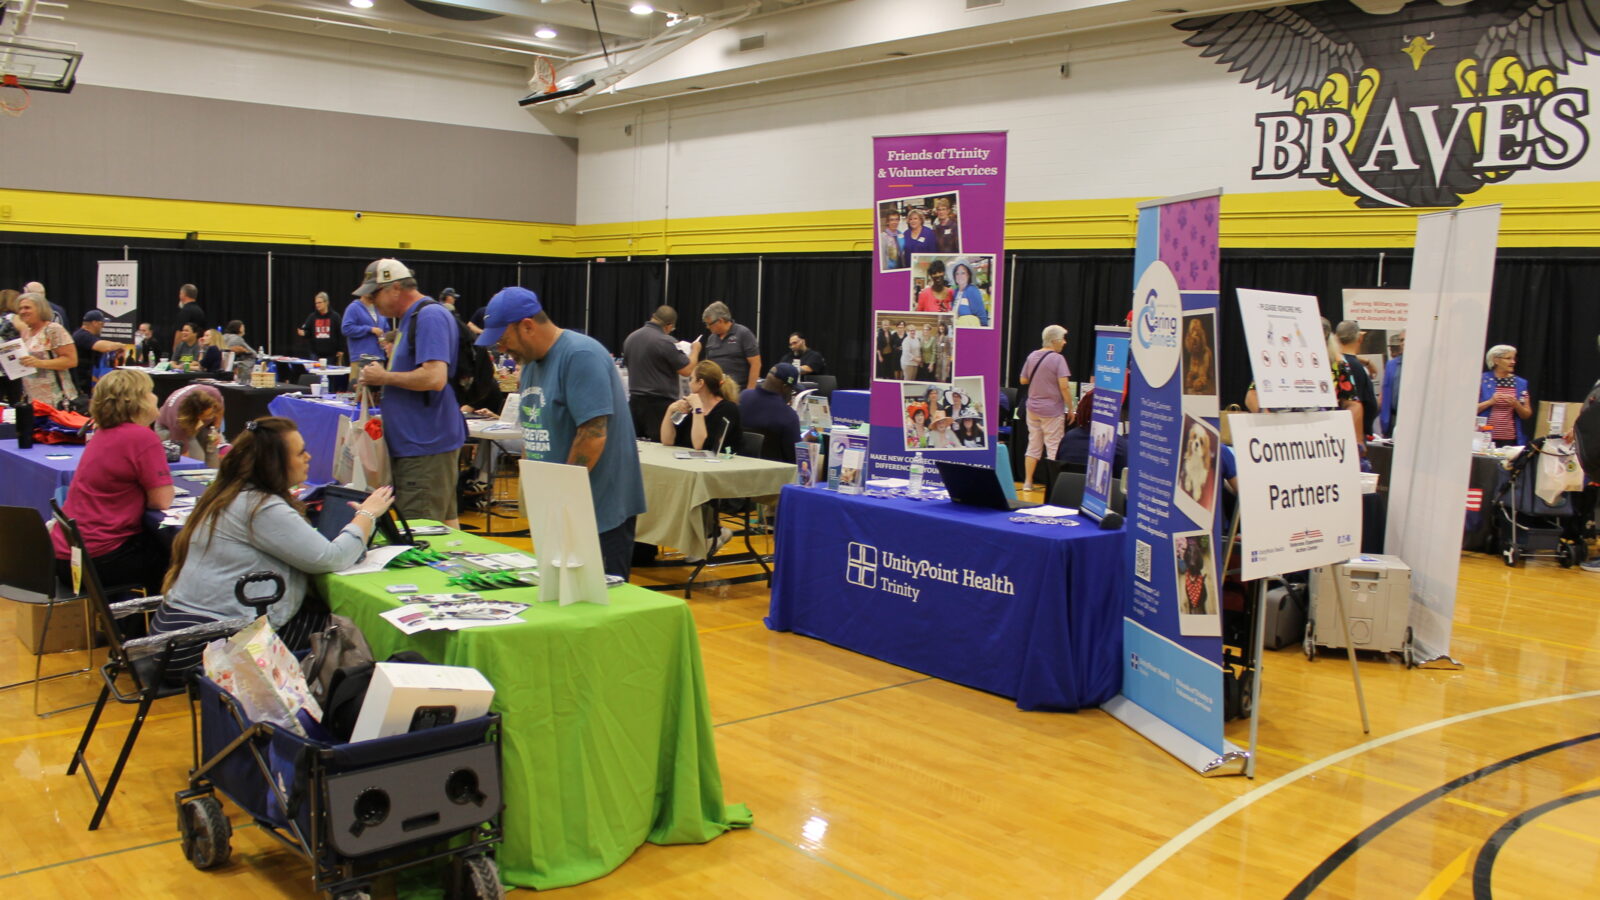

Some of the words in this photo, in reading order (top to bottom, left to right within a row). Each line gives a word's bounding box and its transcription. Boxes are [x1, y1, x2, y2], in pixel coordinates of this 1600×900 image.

[887, 150, 932, 161] Friends
[934, 148, 946, 160] of
[946, 147, 991, 160] Trinity
[1252, 88, 1590, 207] BRAVES
[878, 168, 887, 178] &
[888, 166, 946, 178] Volunteer
[946, 165, 998, 177] Services
[105, 273, 129, 287] REBOOT
[870, 453, 888, 461] MAKE
[1249, 433, 1345, 463] Community
[875, 462, 911, 471] DIFFERENC
[1269, 484, 1339, 510] Partners
[882, 551, 959, 585] UnityPoint
[962, 568, 1015, 596] Health
[880, 576, 920, 602] Trinity
